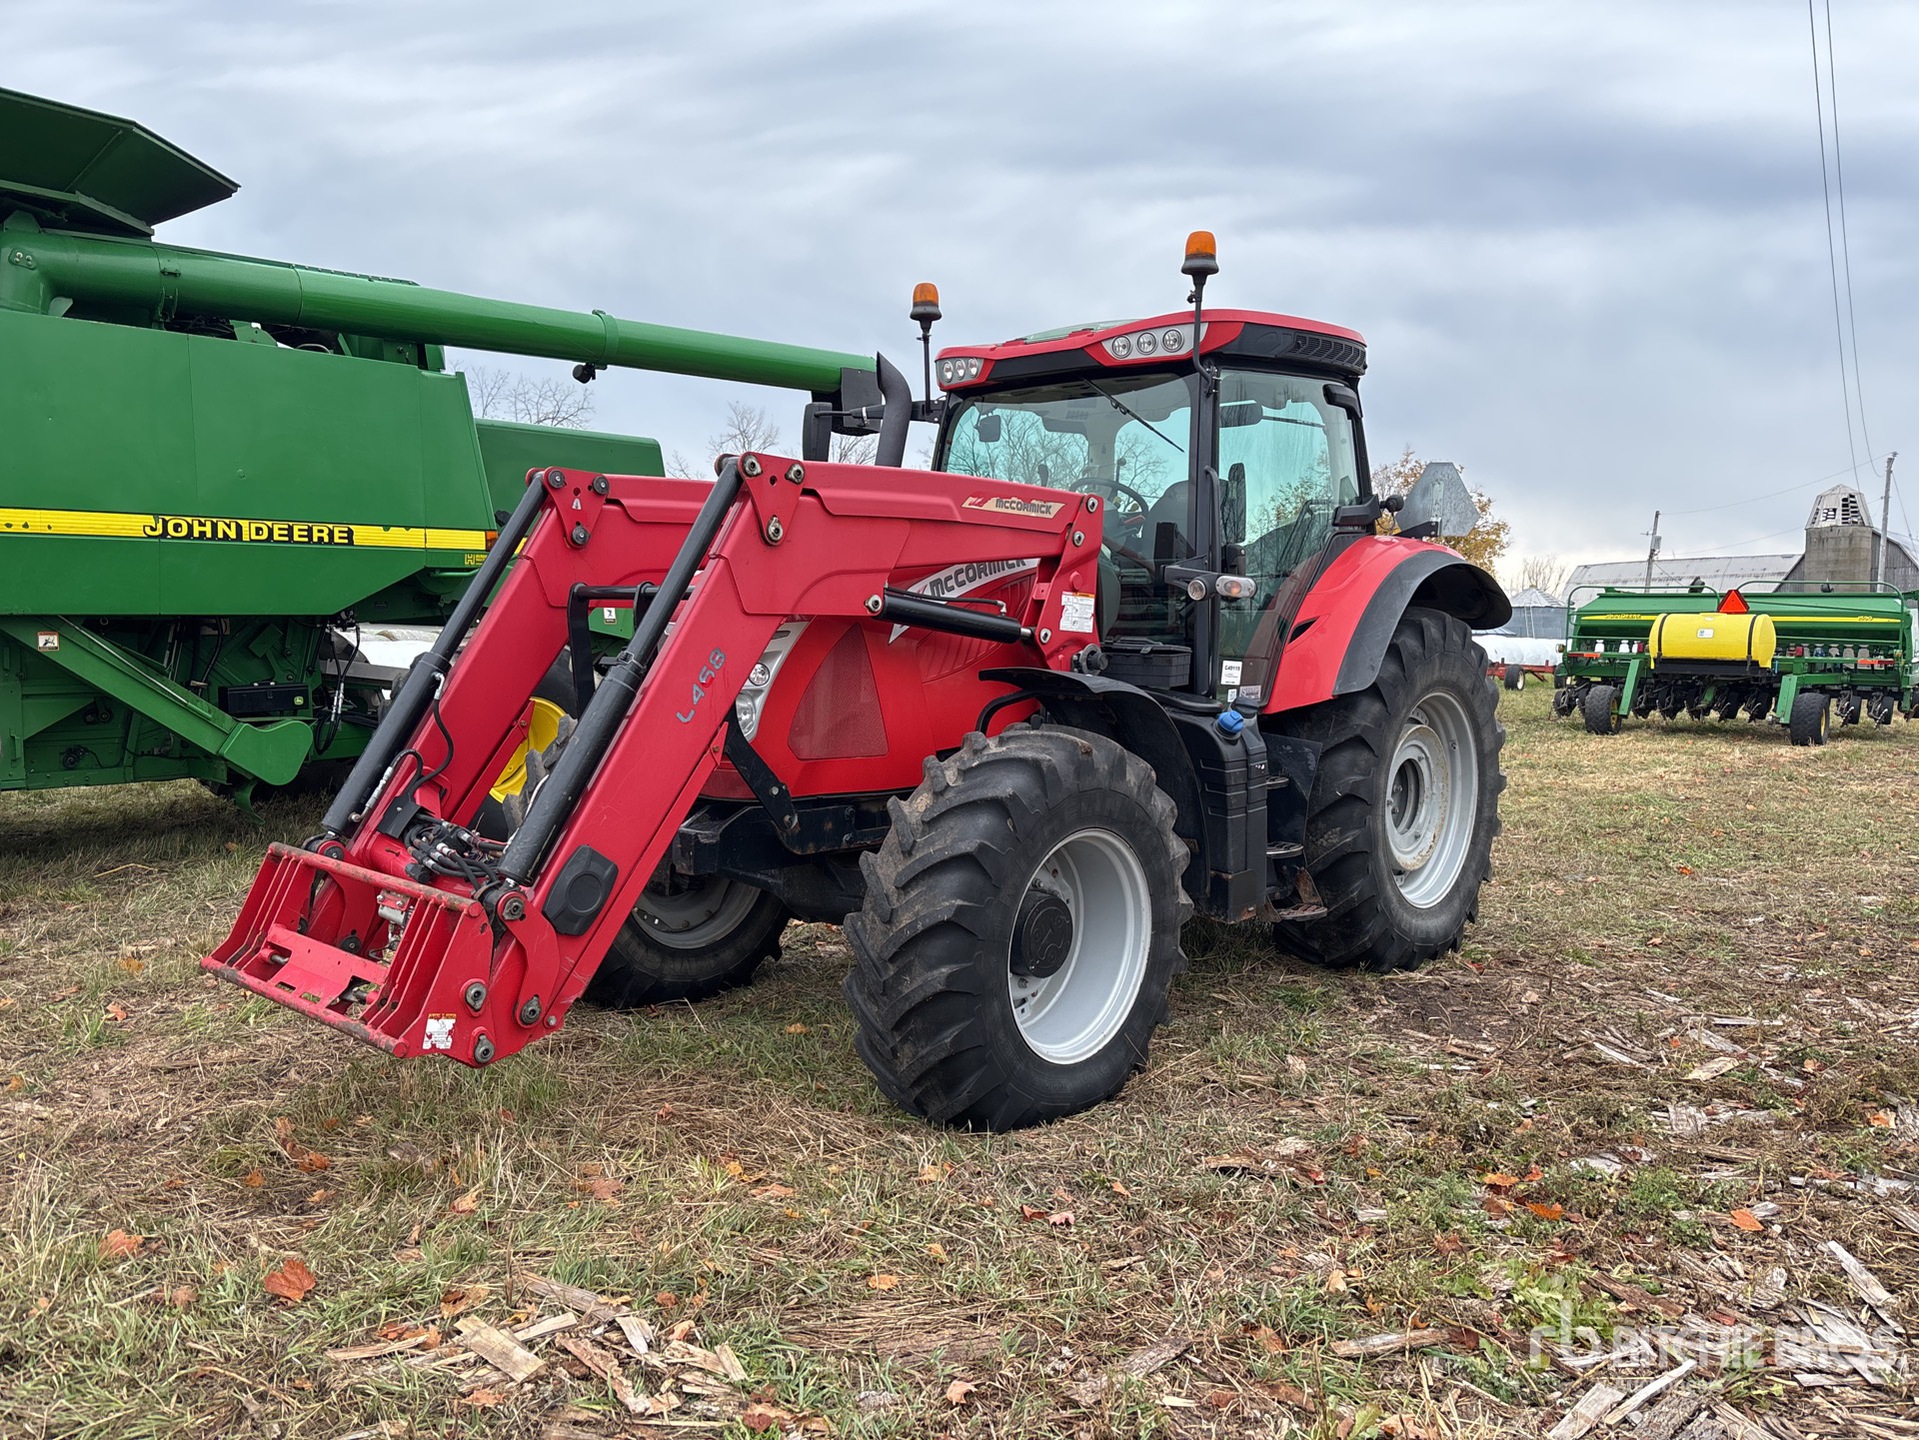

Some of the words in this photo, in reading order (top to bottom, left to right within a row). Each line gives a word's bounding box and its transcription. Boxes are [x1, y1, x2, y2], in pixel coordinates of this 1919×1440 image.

[143, 516, 240, 541] JOHN
[250, 521, 352, 545] DEERE
[675, 647, 727, 723] L458
